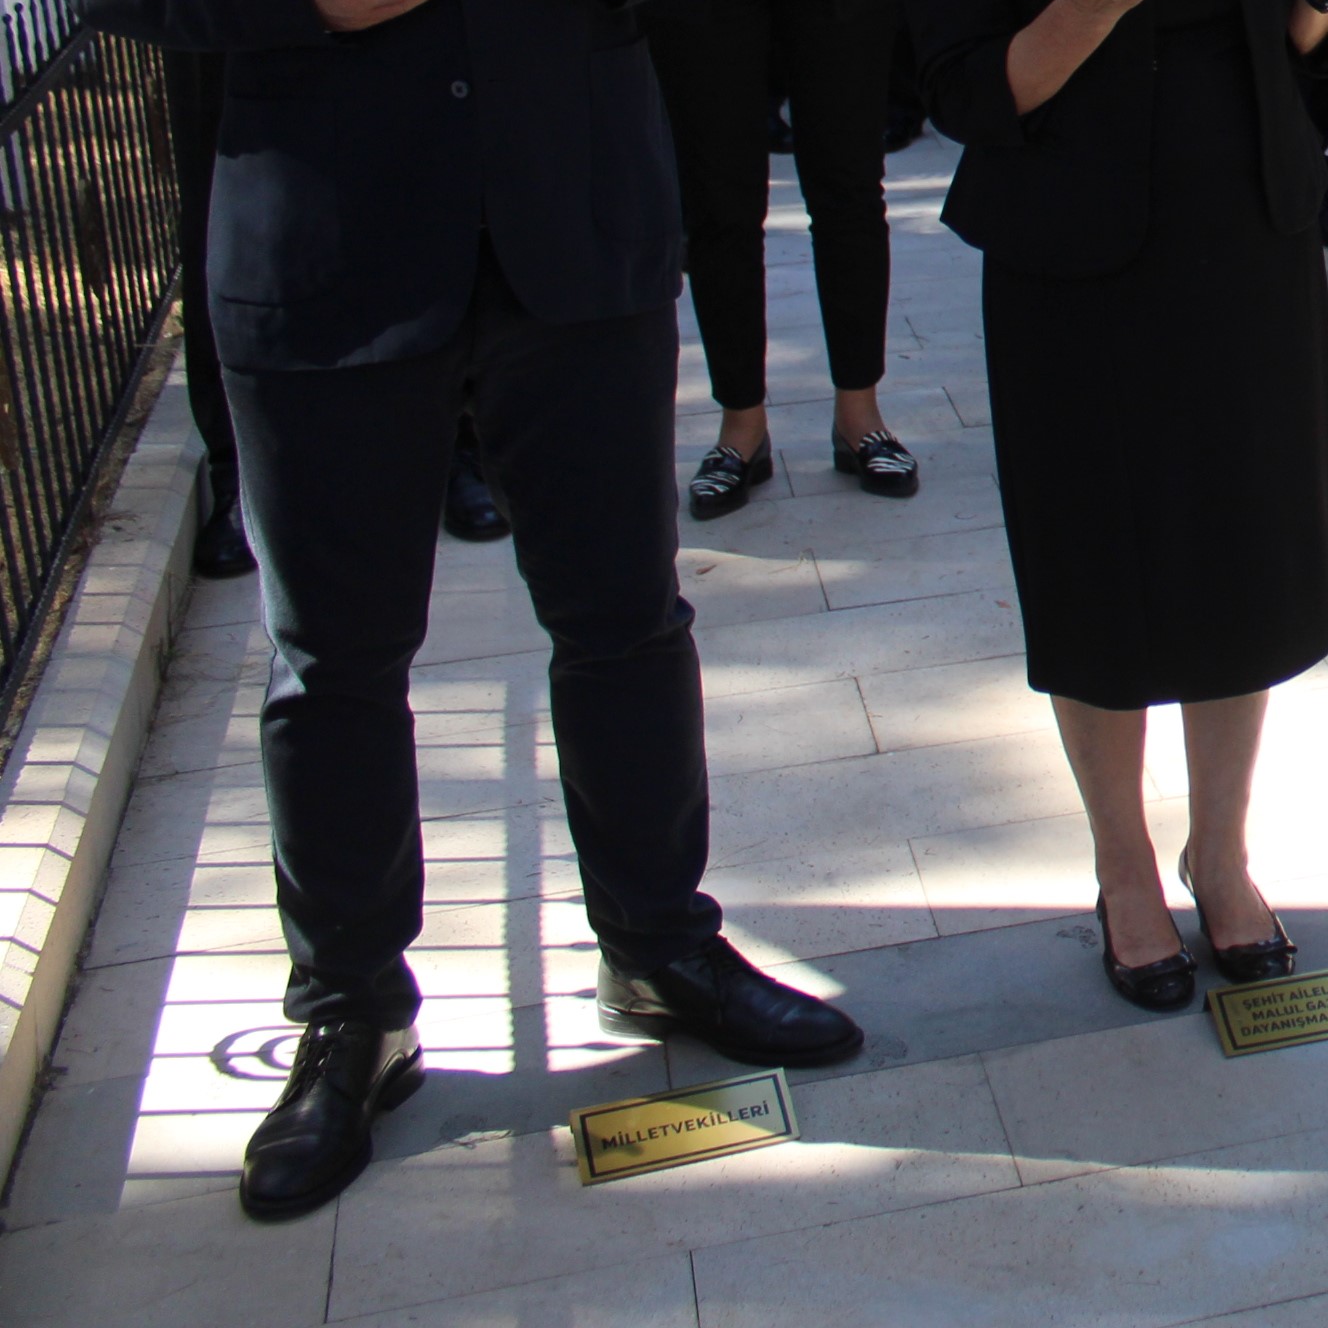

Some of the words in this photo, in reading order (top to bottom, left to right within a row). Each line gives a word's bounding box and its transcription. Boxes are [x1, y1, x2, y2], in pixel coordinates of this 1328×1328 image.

[1242, 991, 1285, 1010] ŞEHİT
[1252, 1005, 1304, 1022] MALUL
[1241, 1013, 1328, 1037] DAYANIŞMA
[601, 1100, 770, 1150] MİLLETVEKİLLERİ
